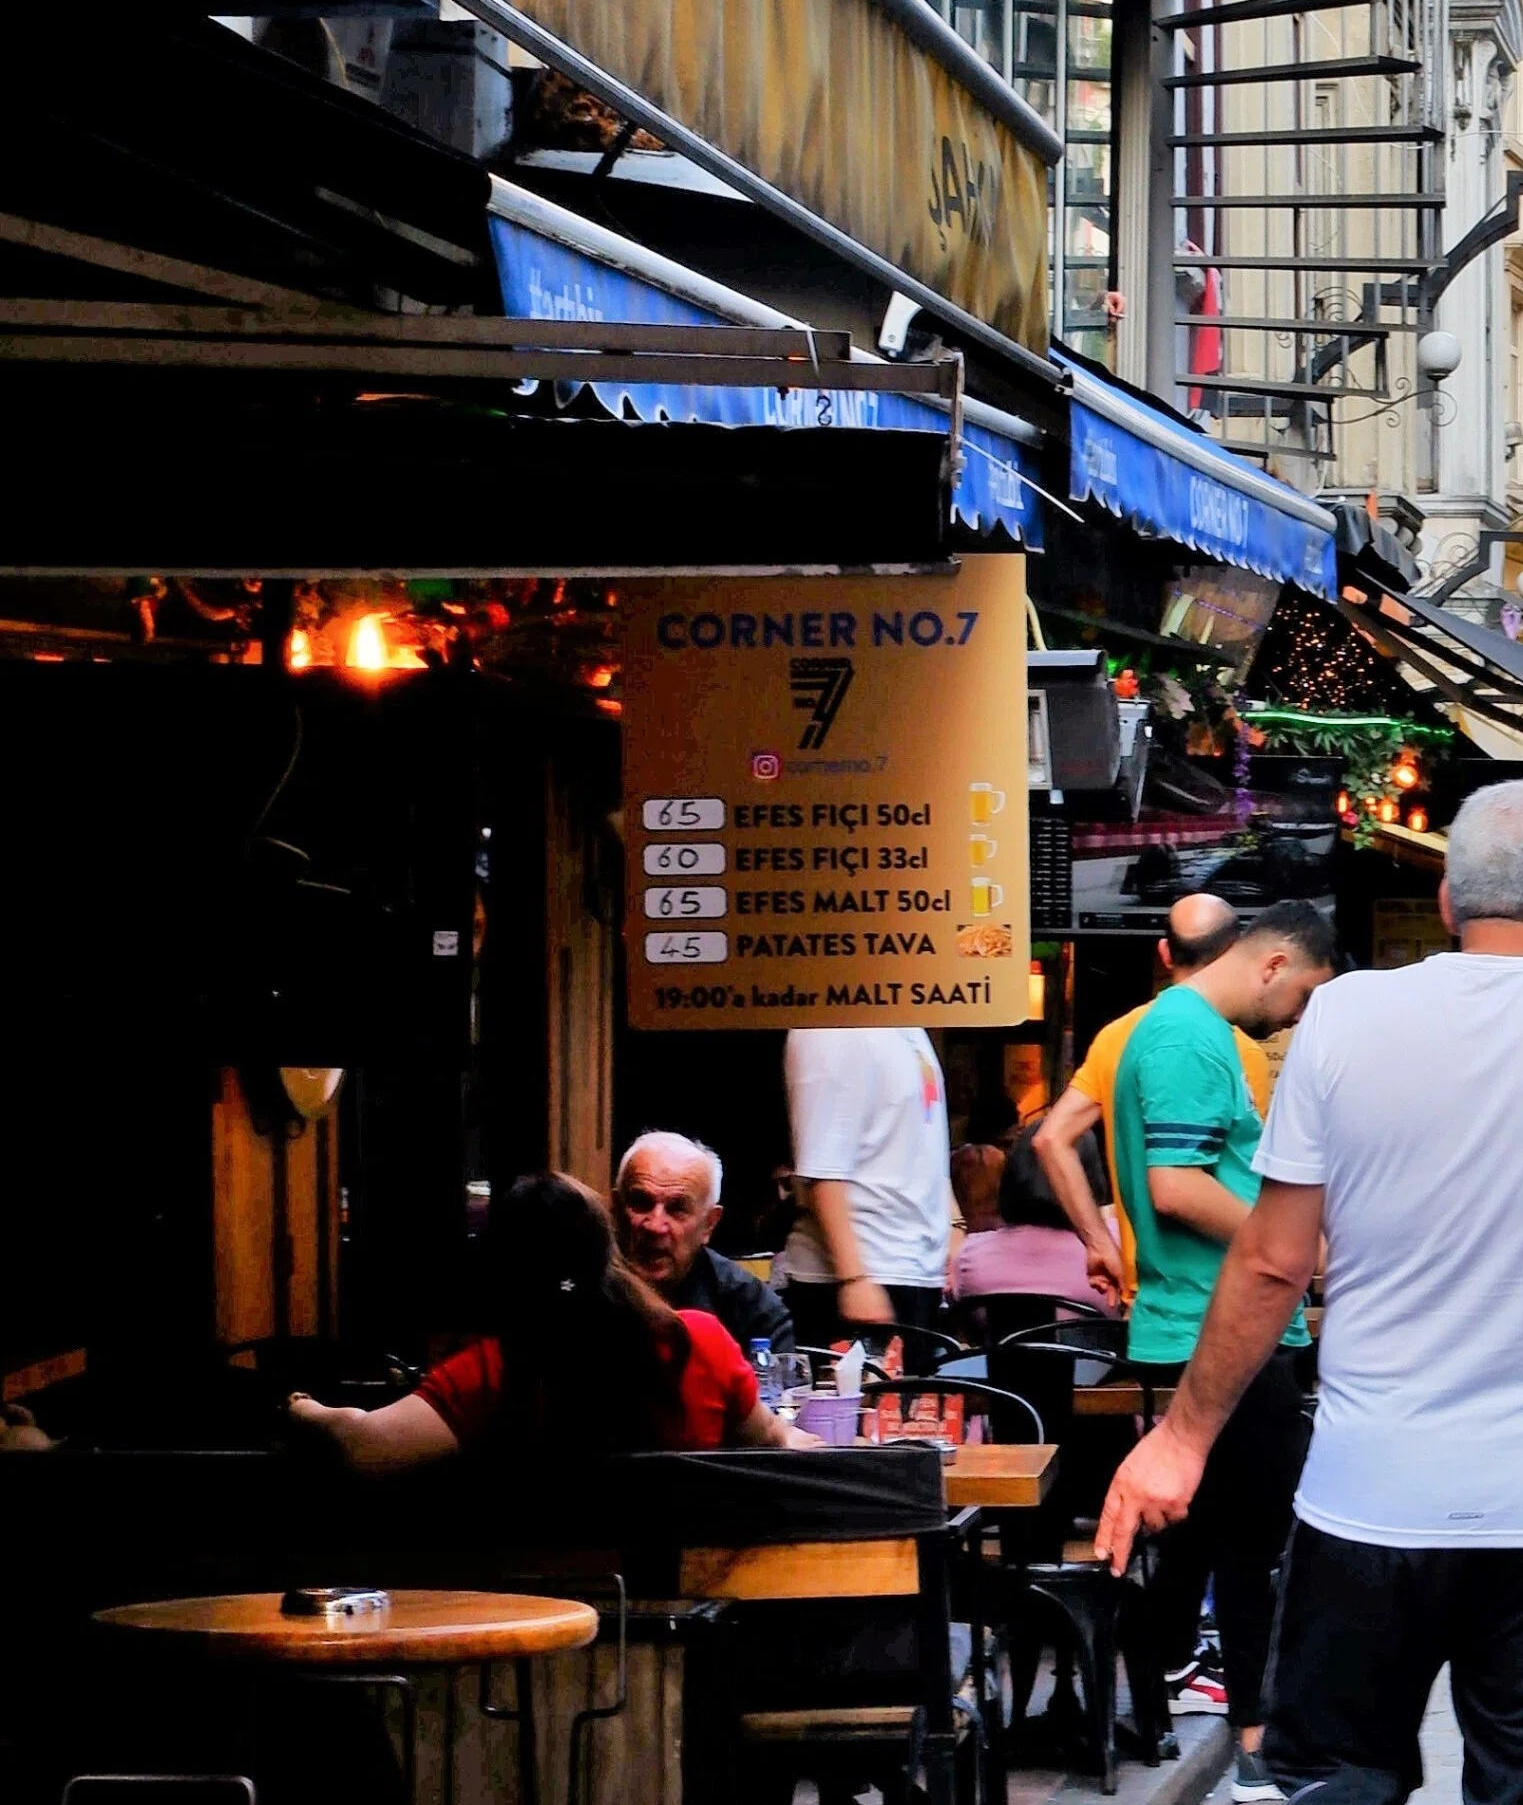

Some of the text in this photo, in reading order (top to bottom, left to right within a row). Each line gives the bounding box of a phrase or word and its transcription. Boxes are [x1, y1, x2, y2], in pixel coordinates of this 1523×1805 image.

[656, 610, 979, 649] CORNER NO.7
[658, 801, 701, 826] 65
[734, 803, 931, 834] EFES FIÇI 50cl
[657, 847, 699, 869] 60
[736, 847, 928, 876] EFES FIÇI 33cl
[659, 891, 701, 915] 65
[736, 889, 951, 914] EFES MALT 50cl
[660, 937, 701, 958] 45
[736, 933, 936, 957] PATATES TAVA
[752, 983, 817, 1007] kadar
[826, 983, 903, 1005] MALT
[910, 975, 991, 1004] SAATİ
